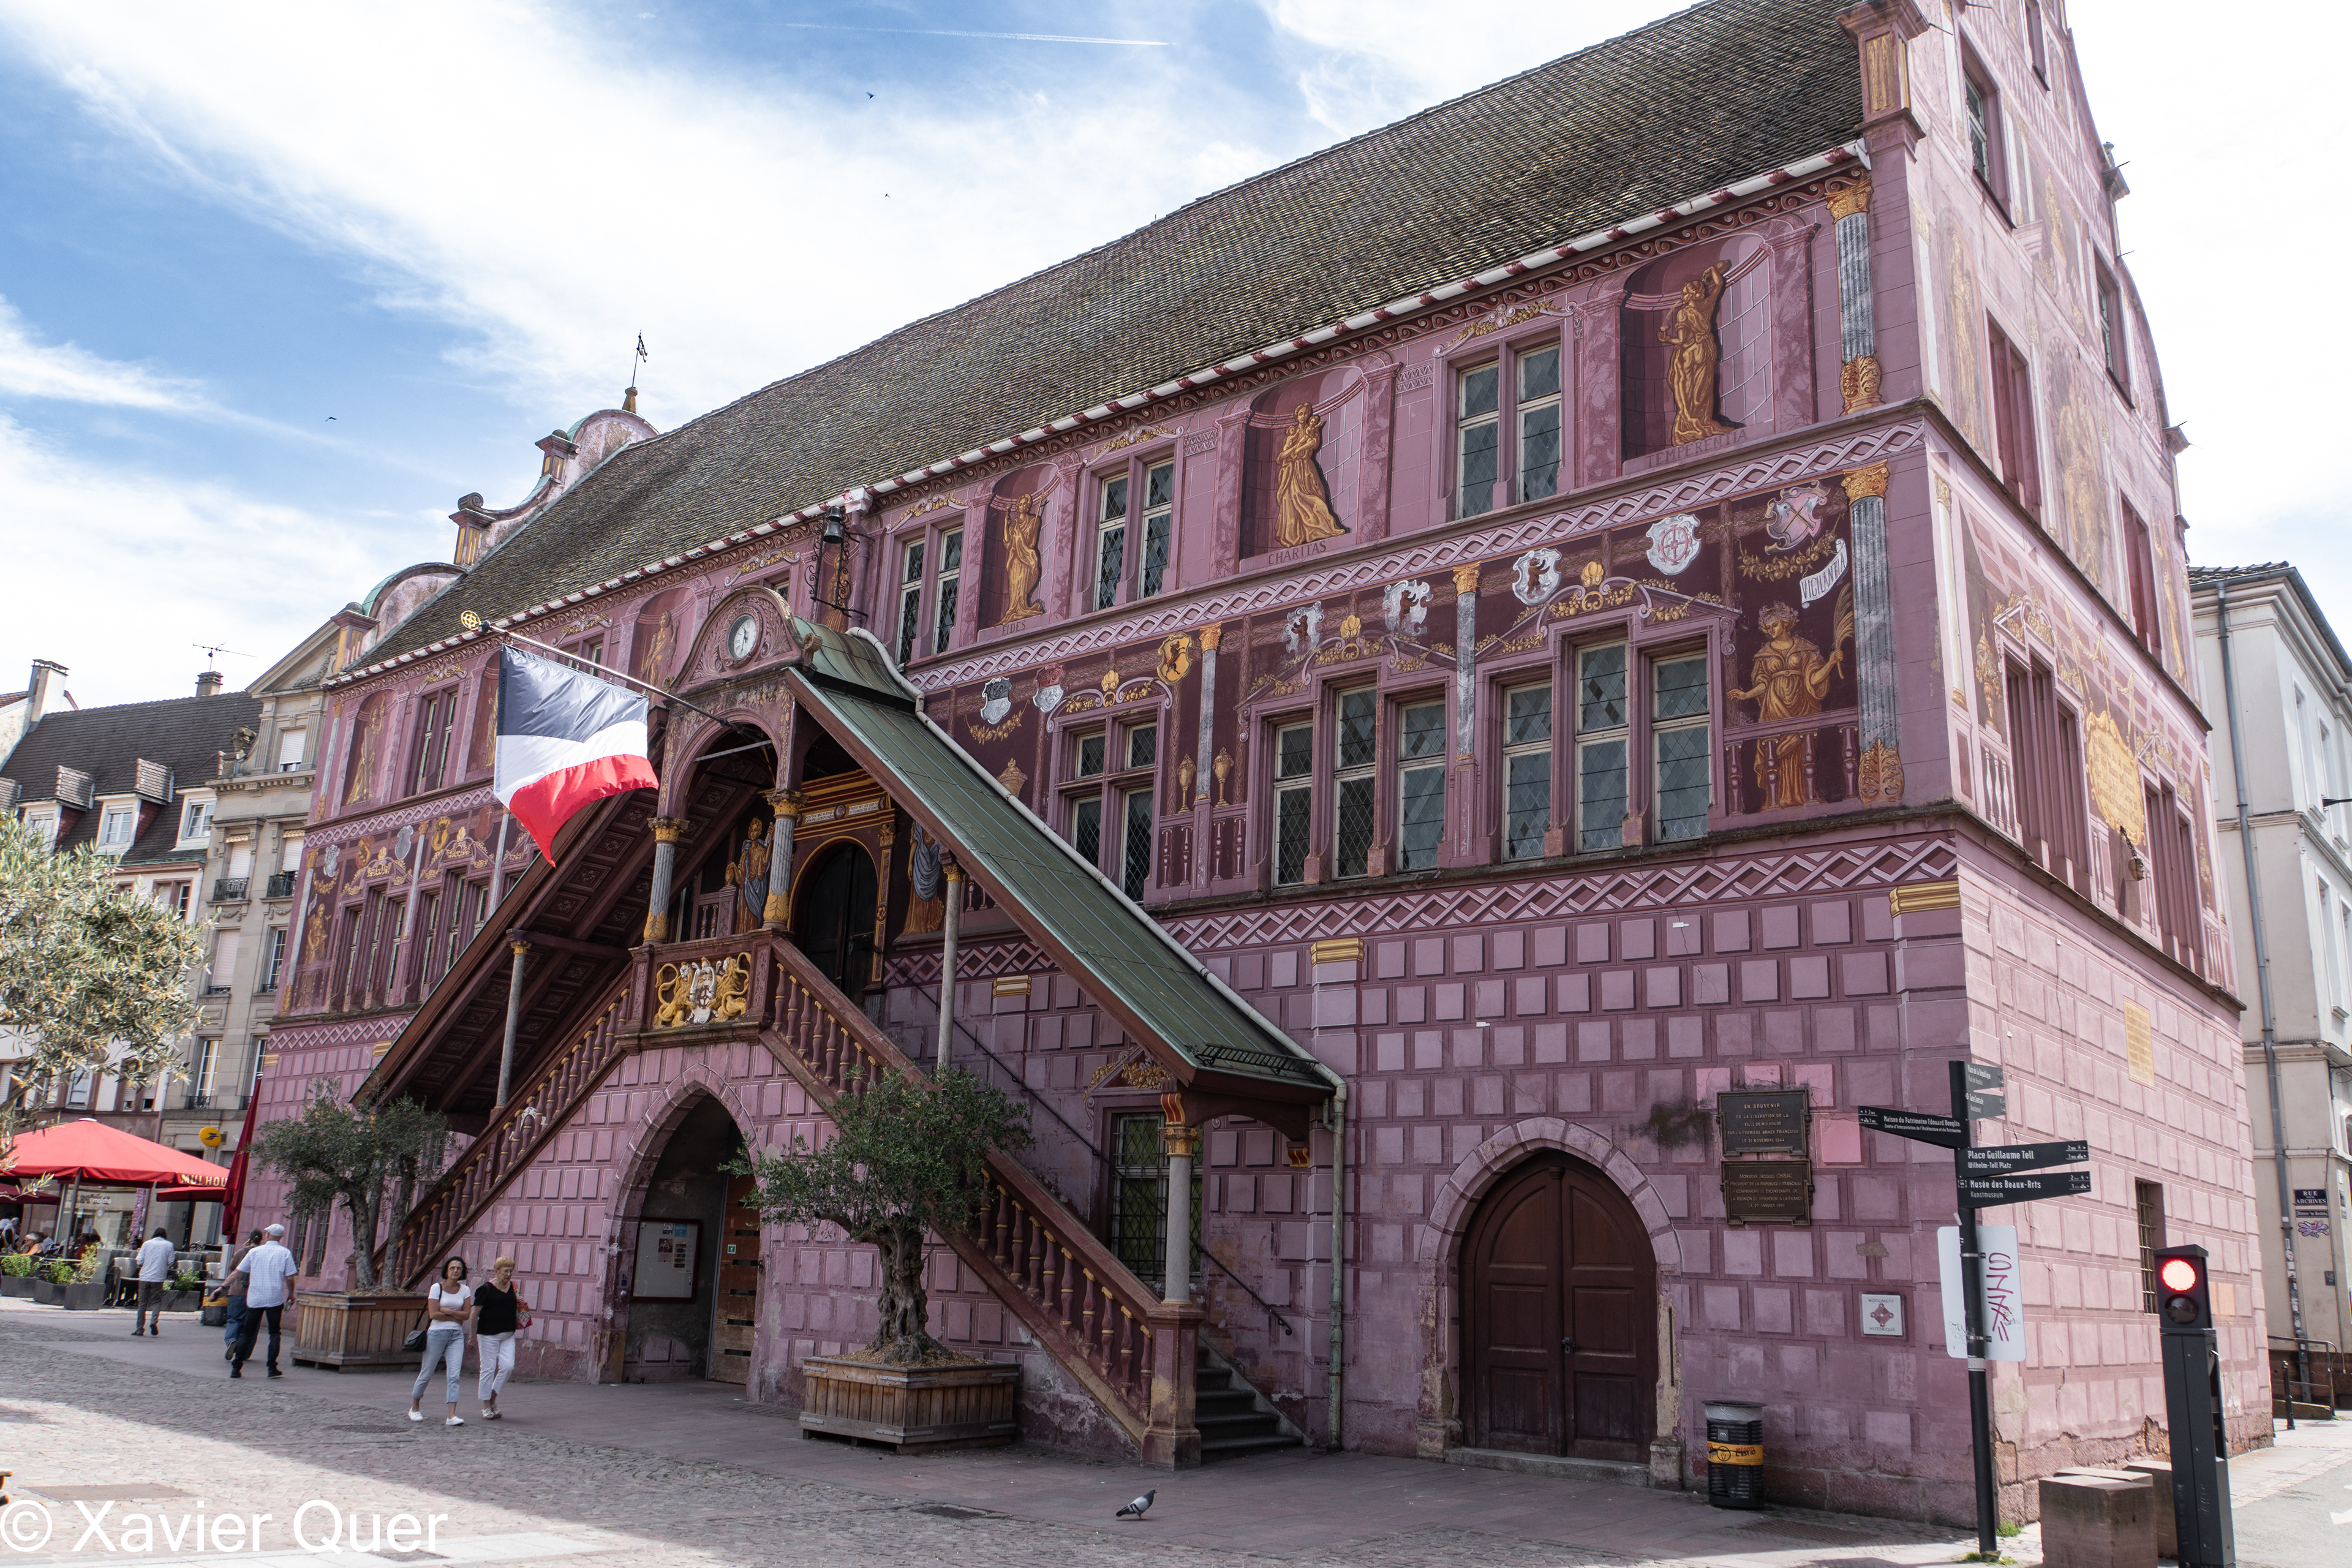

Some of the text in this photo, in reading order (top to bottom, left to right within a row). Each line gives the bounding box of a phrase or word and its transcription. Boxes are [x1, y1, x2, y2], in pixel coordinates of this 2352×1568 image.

[1646, 429, 1749, 468] TEMPERENTIA
[1268, 540, 1327, 565] CHARITAS
[1801, 552, 1845, 600] VIGILANTIA
[1001, 620, 1026, 636] FIDES
[1905, 1117, 1928, 1125] Patrimoine
[1967, 1150, 2034, 1159] Place Guillaume Tell
[1970, 1180, 2041, 1188] Musée des Beaux-Arts
